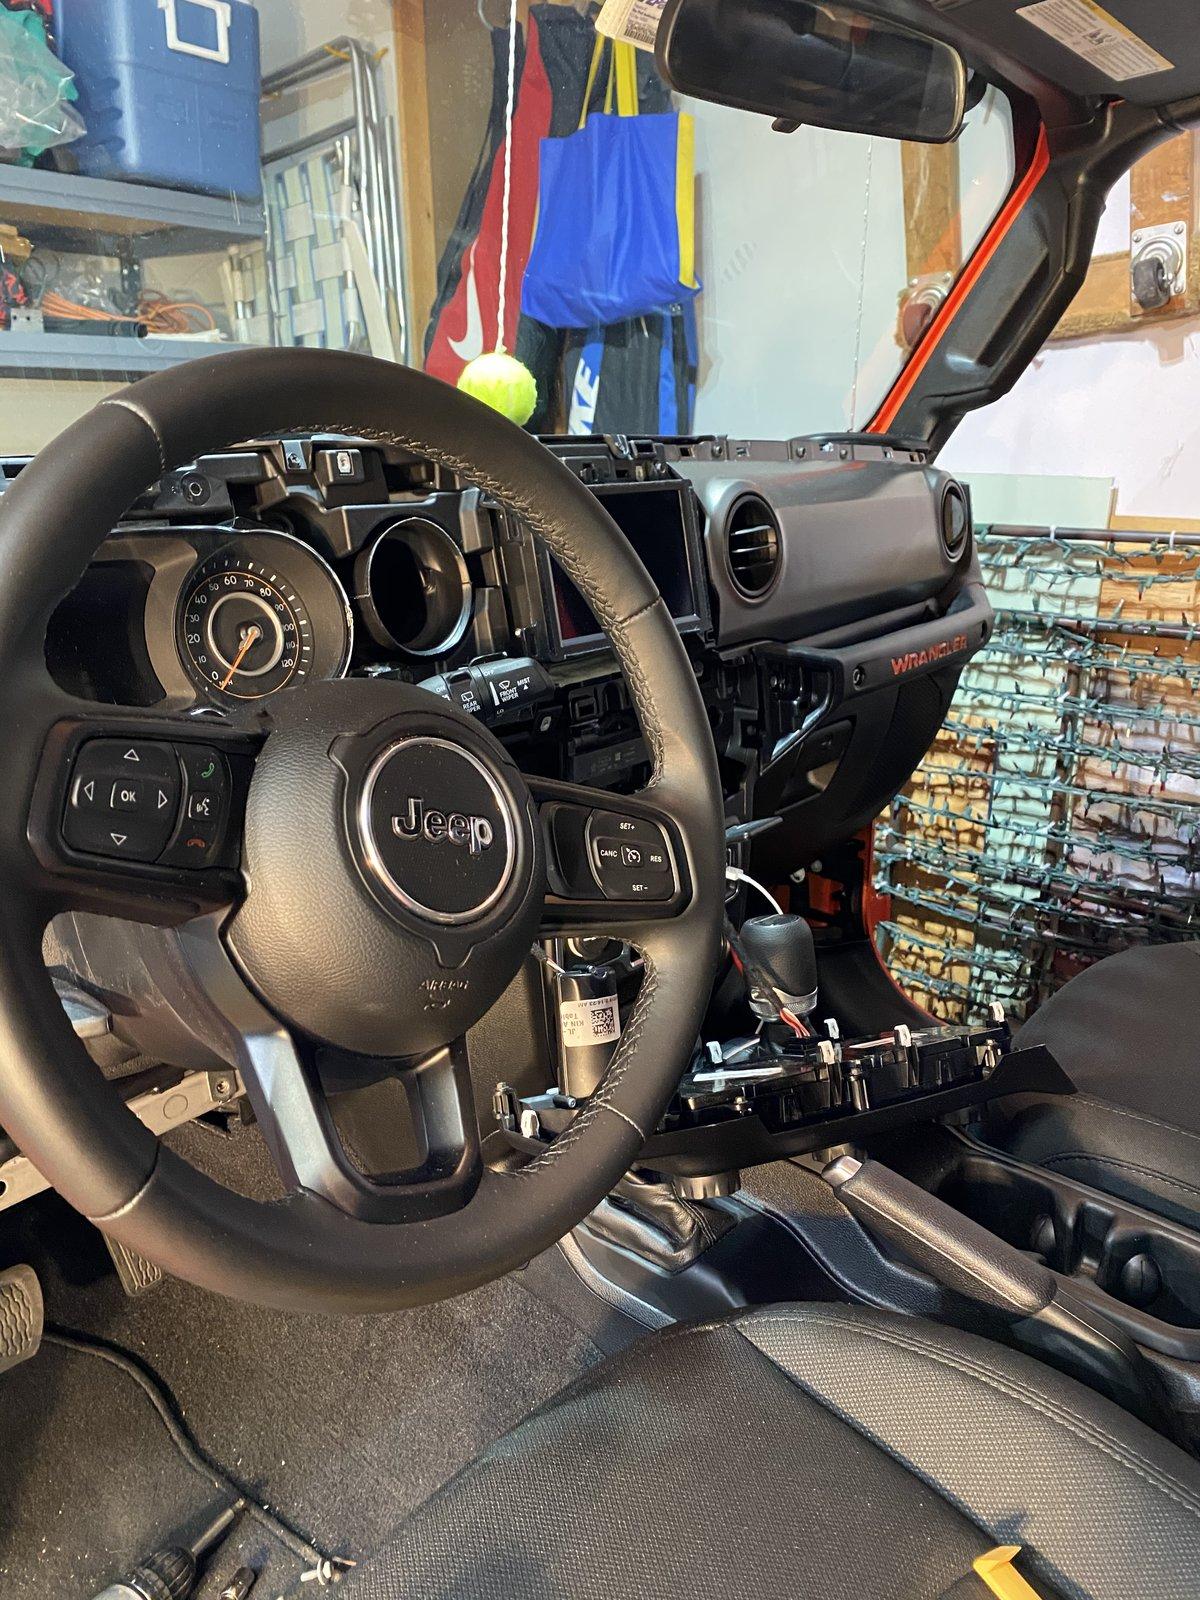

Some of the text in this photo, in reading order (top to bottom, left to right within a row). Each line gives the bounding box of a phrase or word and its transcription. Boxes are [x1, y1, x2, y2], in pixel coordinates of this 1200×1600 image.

[224, 575, 237, 586] 60
[244, 579, 254, 588] 70
[208, 582, 219, 591] 50
[260, 587, 272, 597] 80
[195, 594, 207, 604] 40
[274, 603, 285, 612] 90
[190, 614, 200, 623] 30
[283, 622, 295, 632] 100
[188, 633, 200, 644] 20
[285, 641, 296, 650] 110
[891, 633, 968, 675] WRANGLER
[198, 655, 207, 664] 10
[281, 658, 294, 668] 120
[211, 671, 219, 681] 0
[517, 676, 531, 686] MIST
[499, 687, 518, 697] FRONT
[501, 693, 519, 703] WIPER
[462, 700, 478, 710] REAR
[120, 790, 137, 803] OK
[391, 797, 493, 857] Jeep
[600, 849, 618, 858] CANC
[650, 855, 662, 863] RES
